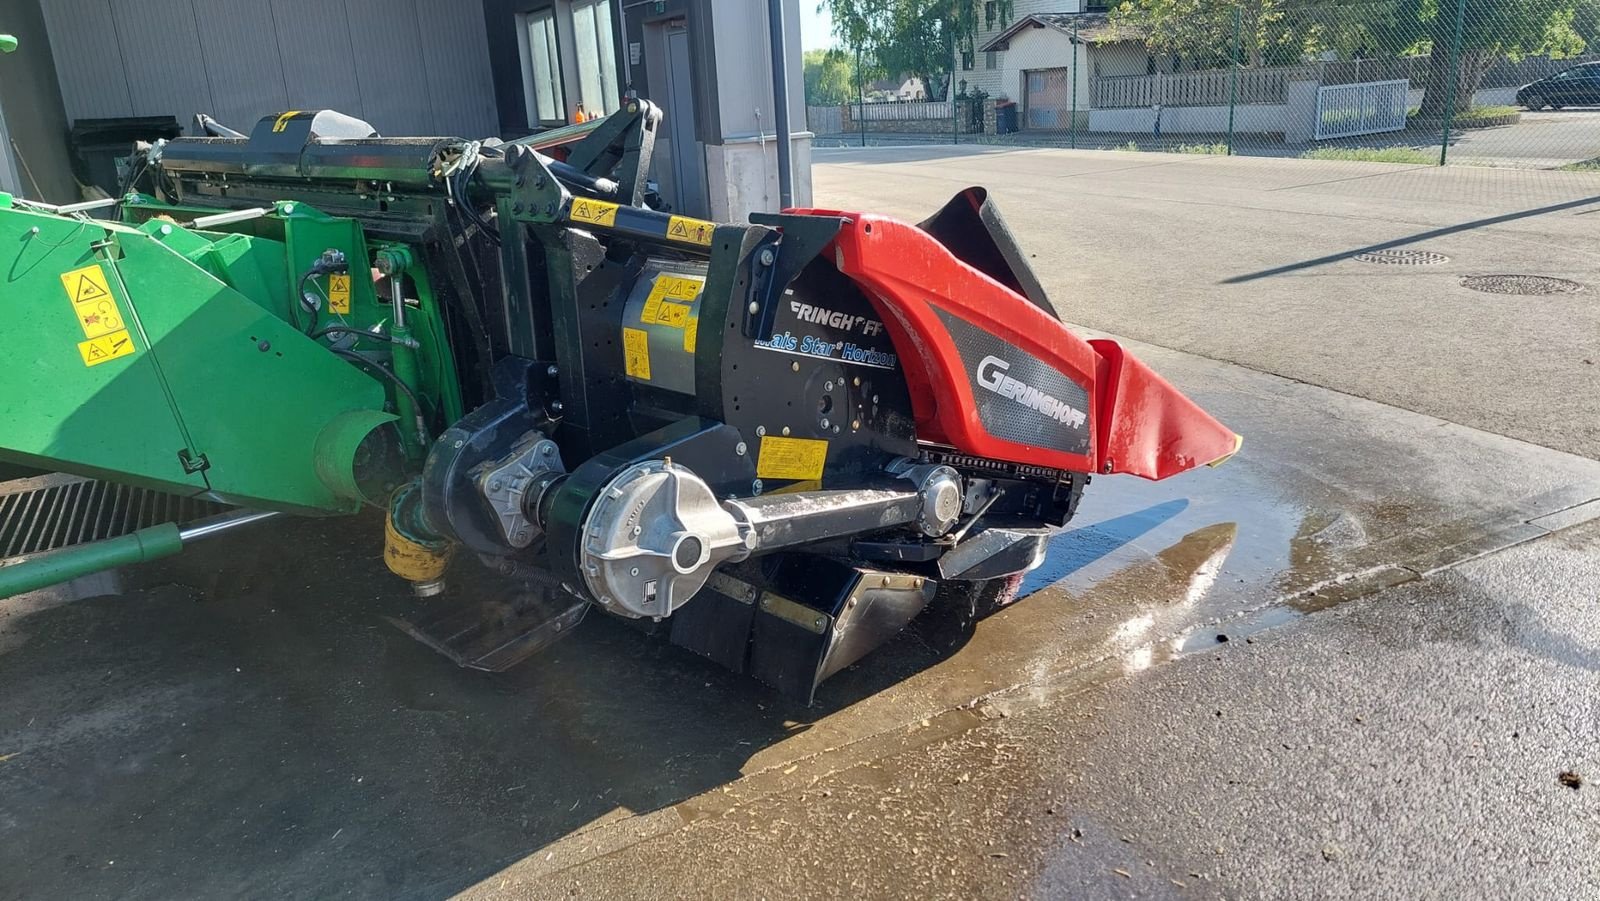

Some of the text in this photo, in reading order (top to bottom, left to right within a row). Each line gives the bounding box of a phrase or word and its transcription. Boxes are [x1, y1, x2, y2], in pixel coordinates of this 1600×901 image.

[755, 331, 797, 350] ais
[842, 342, 896, 366] Horizon
[977, 355, 1086, 429] GERINGHOFF
